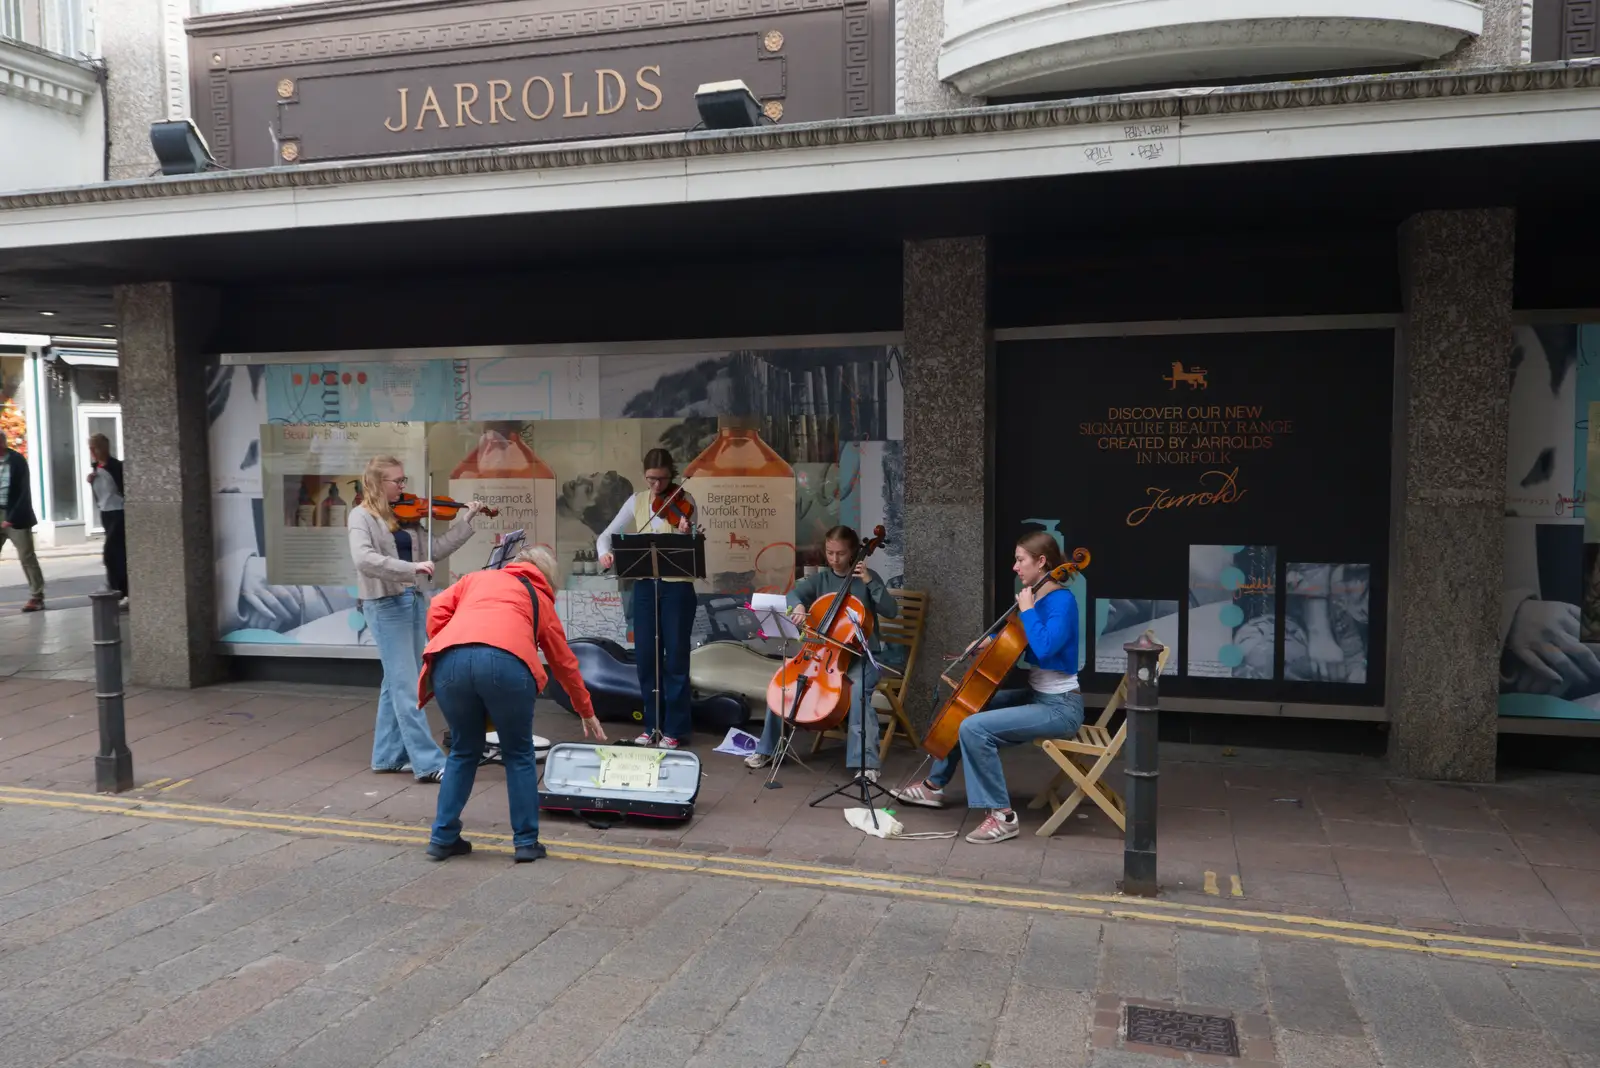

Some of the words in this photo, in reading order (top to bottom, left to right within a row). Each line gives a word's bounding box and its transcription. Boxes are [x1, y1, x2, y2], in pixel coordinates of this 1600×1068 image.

[384, 66, 664, 132] JARROLDS
[1108, 406, 1183, 420] DISCOVER
[1187, 406, 1221, 419] OUR
[1225, 405, 1263, 418] NEW
[1079, 421, 1165, 435] SIGNATURE
[1169, 421, 1231, 434] BEAUTY
[1236, 420, 1293, 434] RANGE
[1097, 436, 1165, 450] CREATED
[1169, 436, 1188, 449] BY
[1191, 436, 1273, 449] JARROLDS
[1136, 451, 1151, 464] IN
[1155, 451, 1232, 464] NORFOLK
[473, 493, 523, 505] Bergamot
[525, 493, 533, 503] &
[707, 493, 760, 506] Bergamot
[763, 492, 770, 503] &
[505, 506, 538, 518] Thyme
[701, 506, 739, 516] Norfolk
[740, 505, 777, 518] Thyme
[709, 519, 737, 529] Hand
[739, 519, 769, 529] Wash
